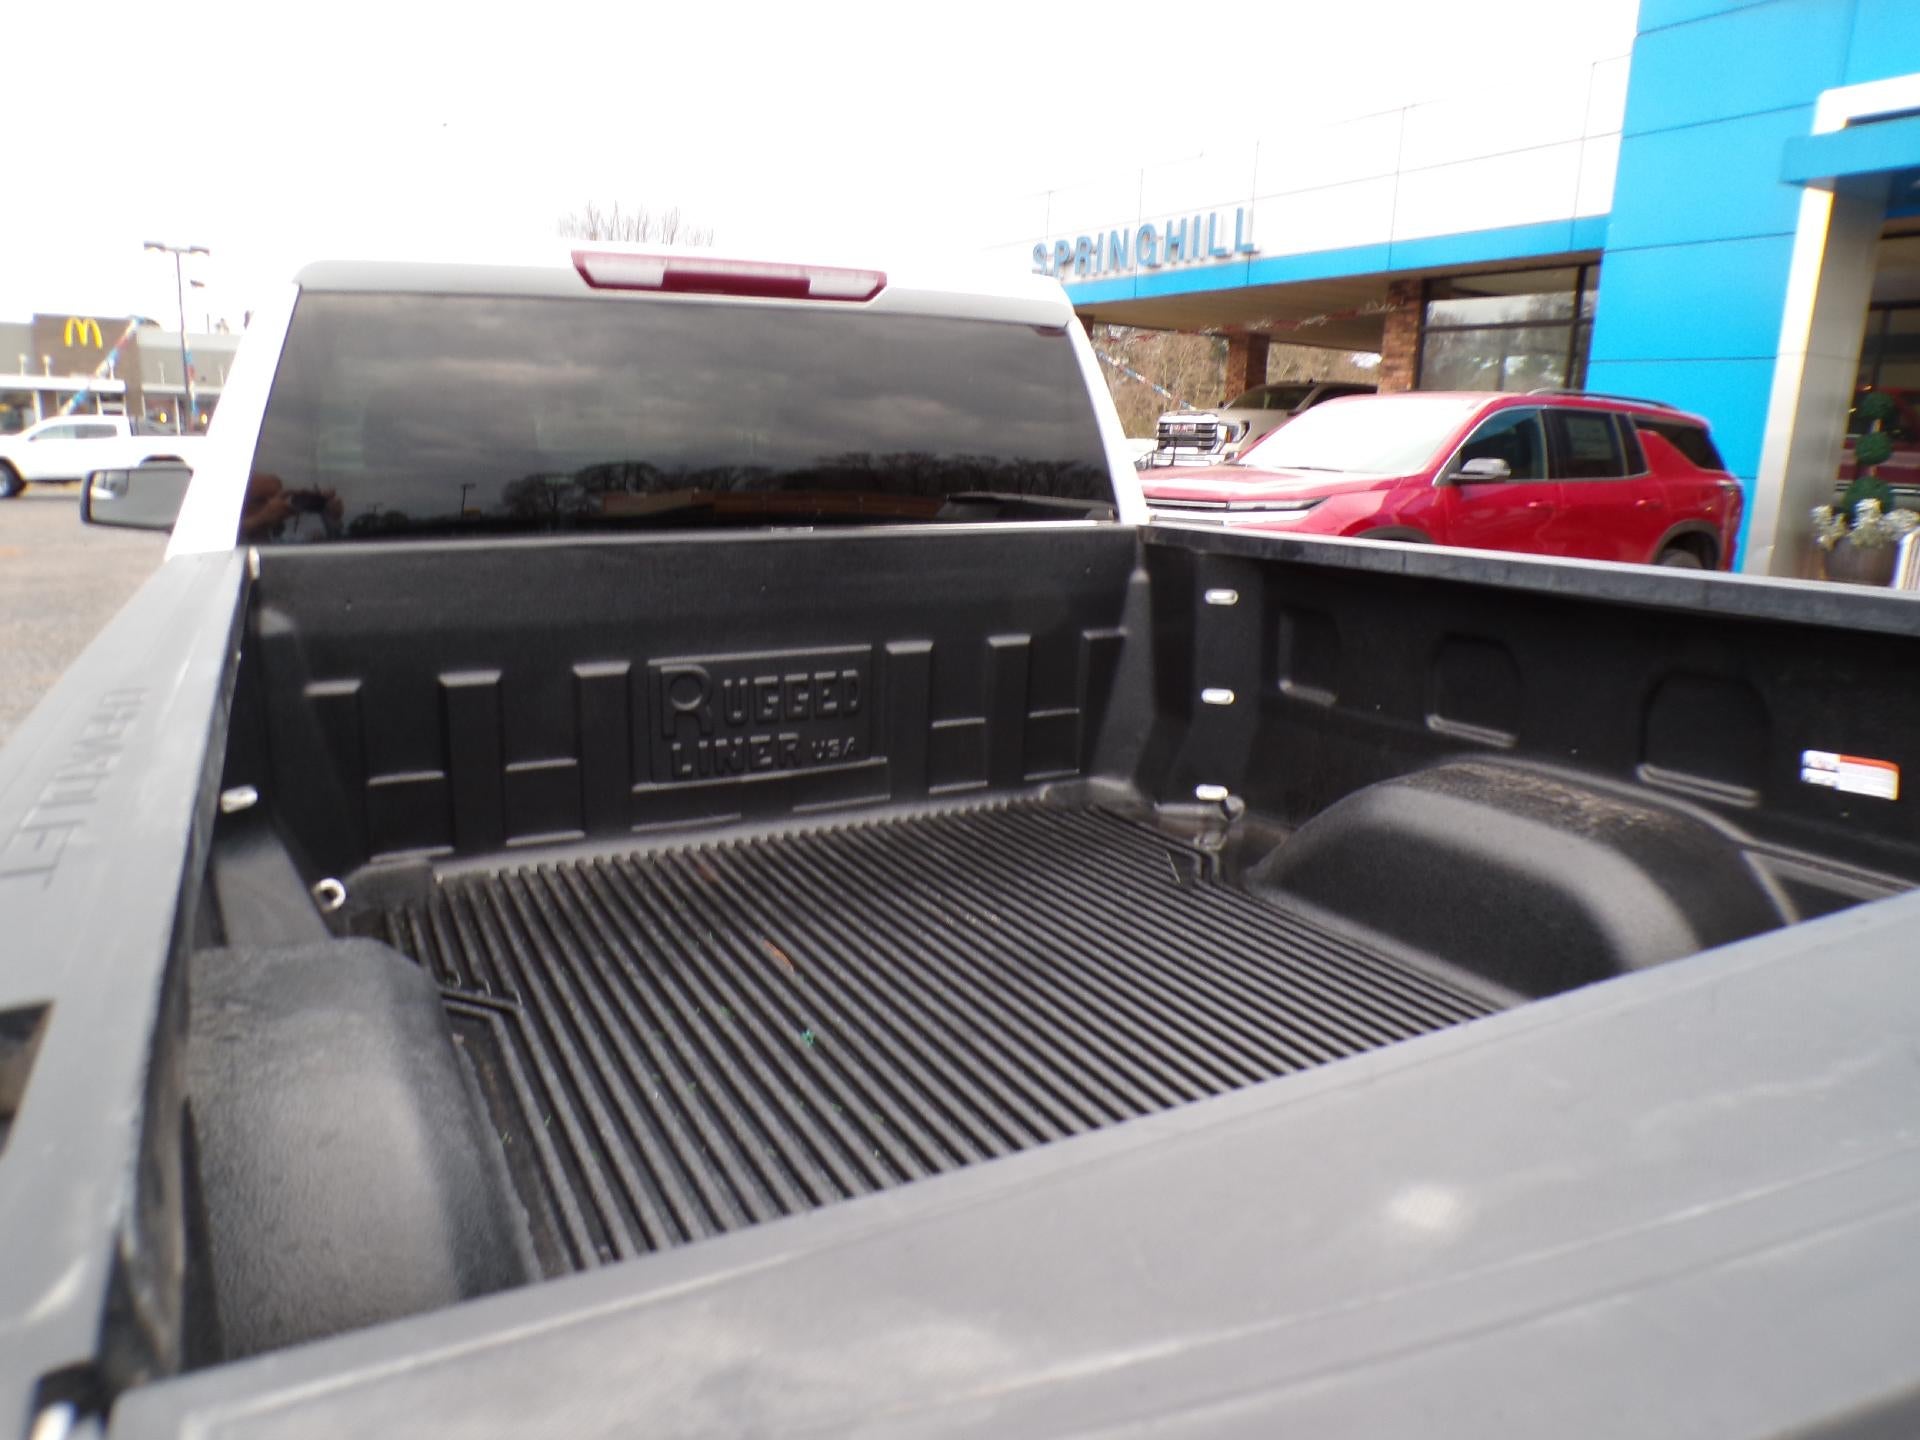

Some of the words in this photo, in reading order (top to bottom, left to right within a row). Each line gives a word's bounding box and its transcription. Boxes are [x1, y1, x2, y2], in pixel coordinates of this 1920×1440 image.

[1032, 207, 1255, 276] SPRINGHILL
[660, 664, 861, 737] RUGGED
[671, 732, 802, 777] LINER
